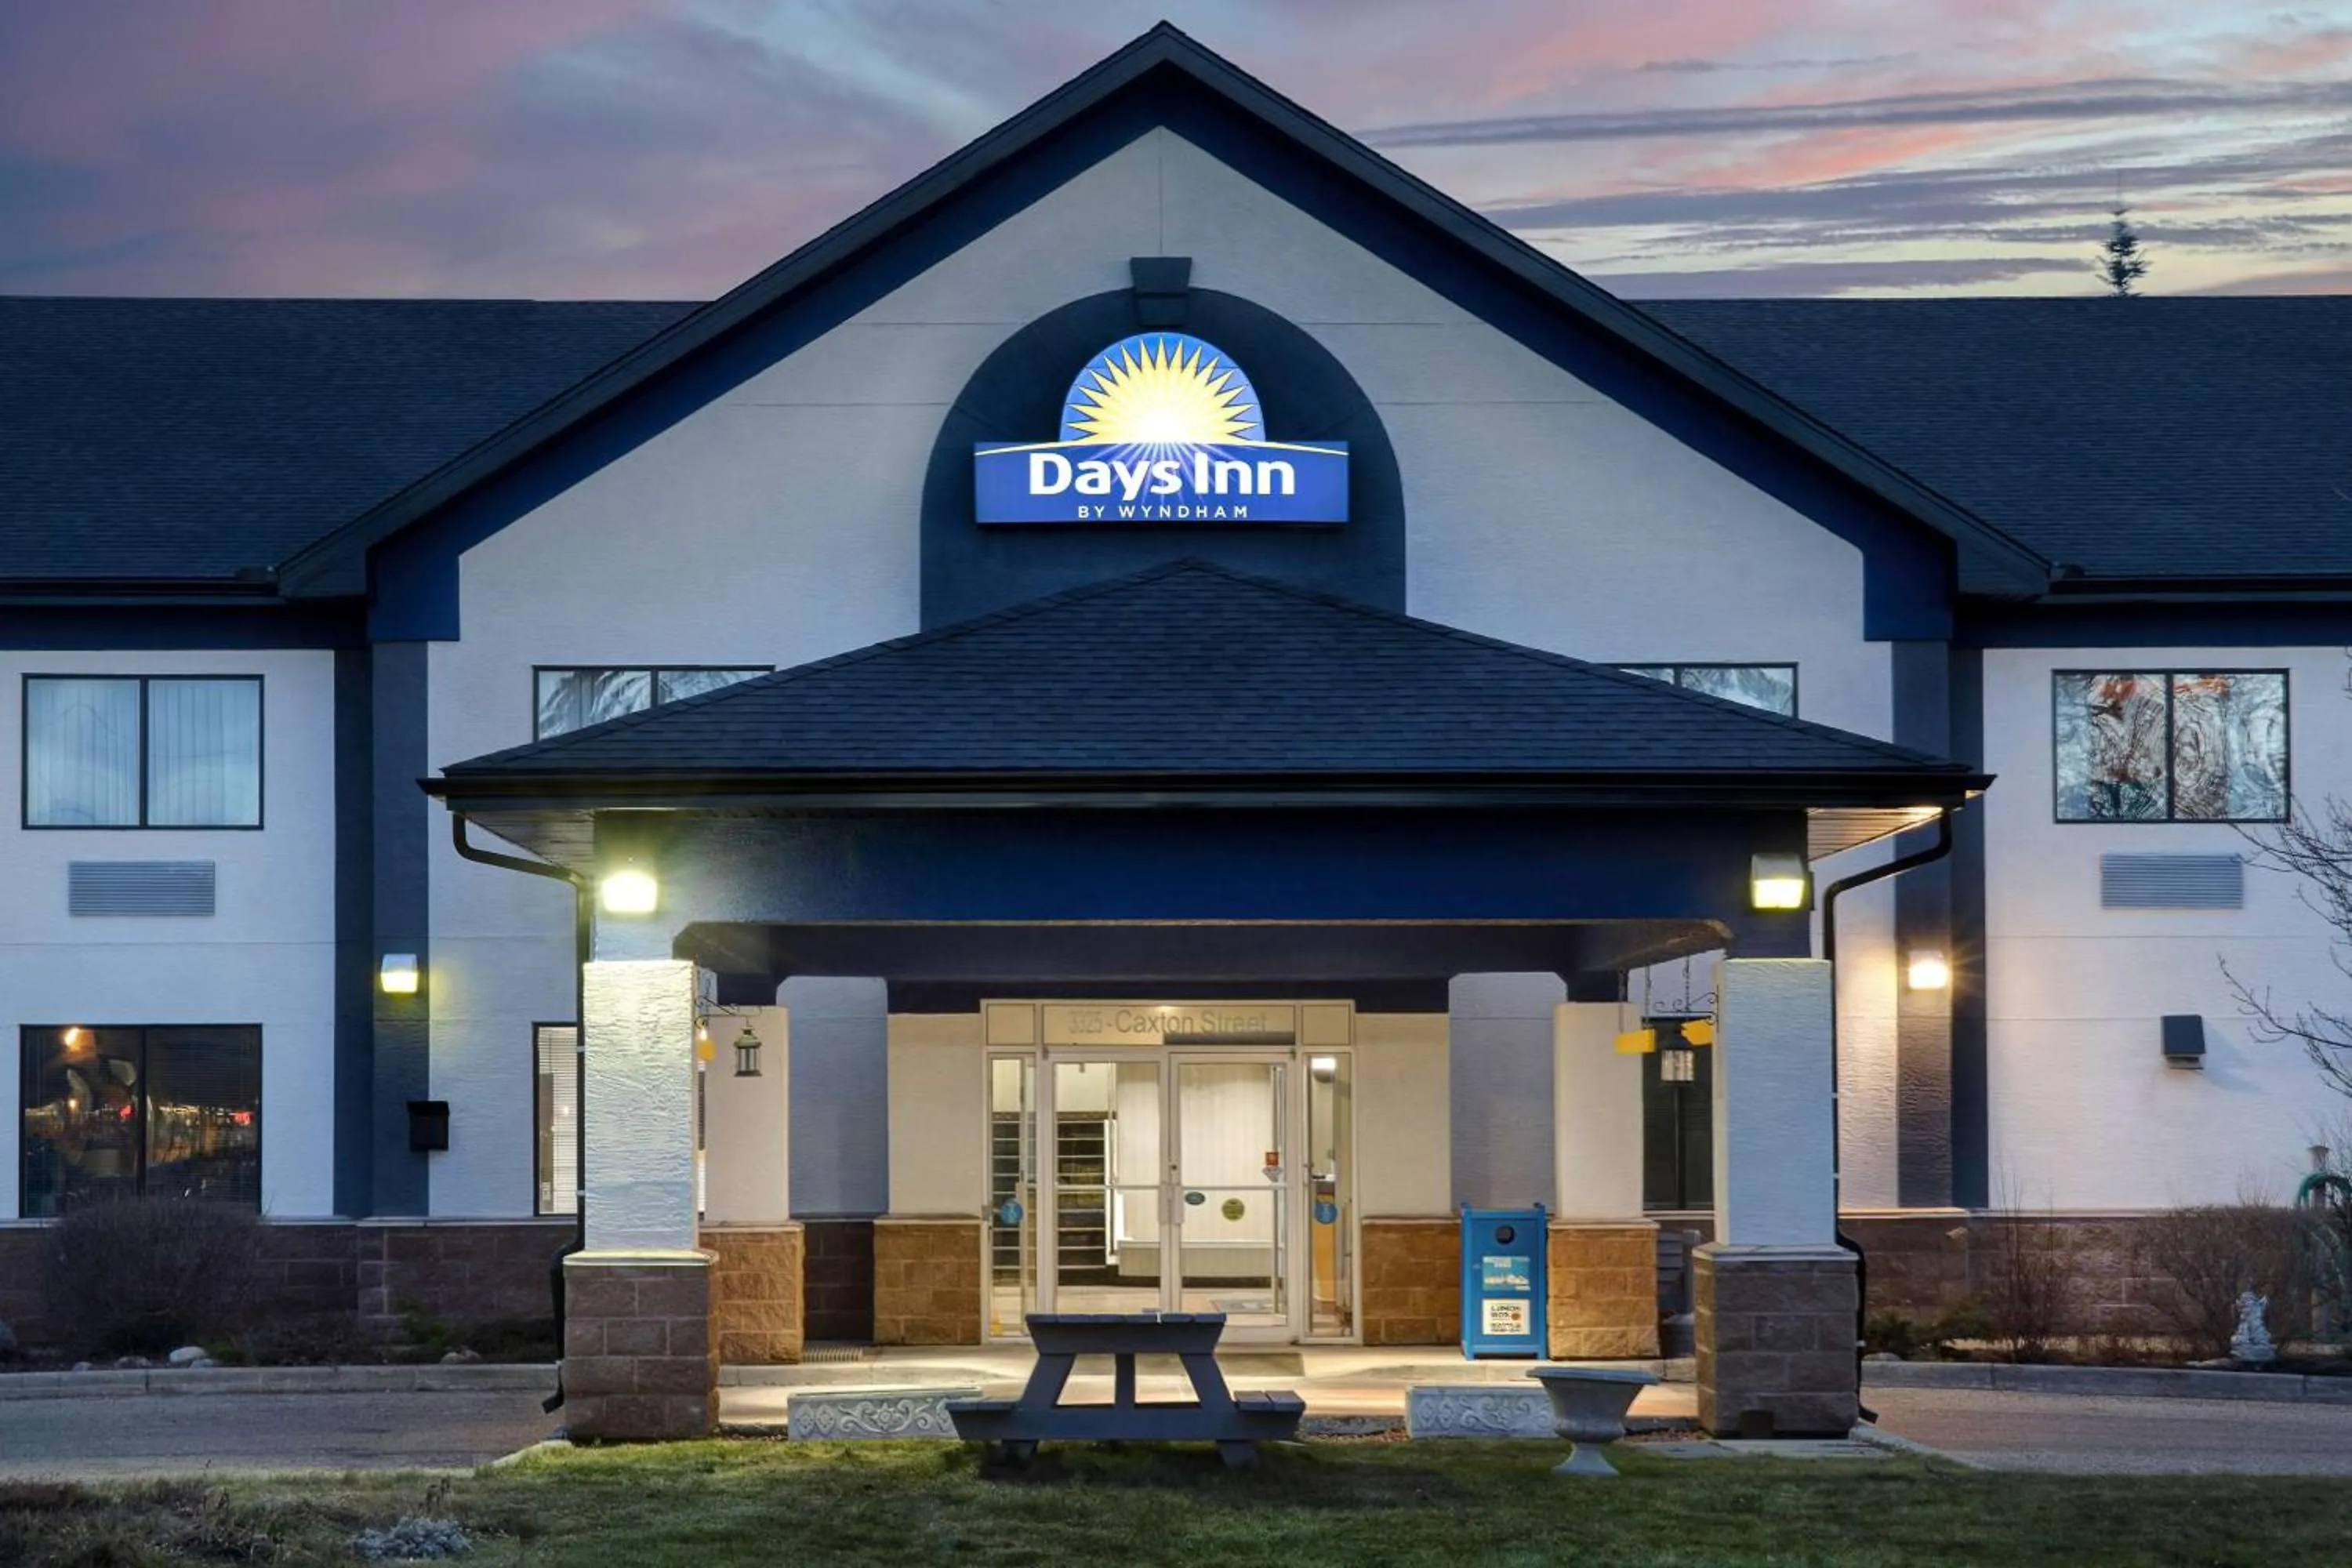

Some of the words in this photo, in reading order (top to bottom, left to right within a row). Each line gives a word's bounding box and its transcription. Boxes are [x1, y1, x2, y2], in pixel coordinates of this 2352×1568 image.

[1029, 452, 1183, 501] Days
[1194, 452, 1295, 495] Inn
[1078, 506, 1105, 518] BY
[1119, 506, 1248, 518] WYNDHAM
[1115, 1009, 1194, 1036] Caxton
[1200, 1010, 1268, 1034] Street
